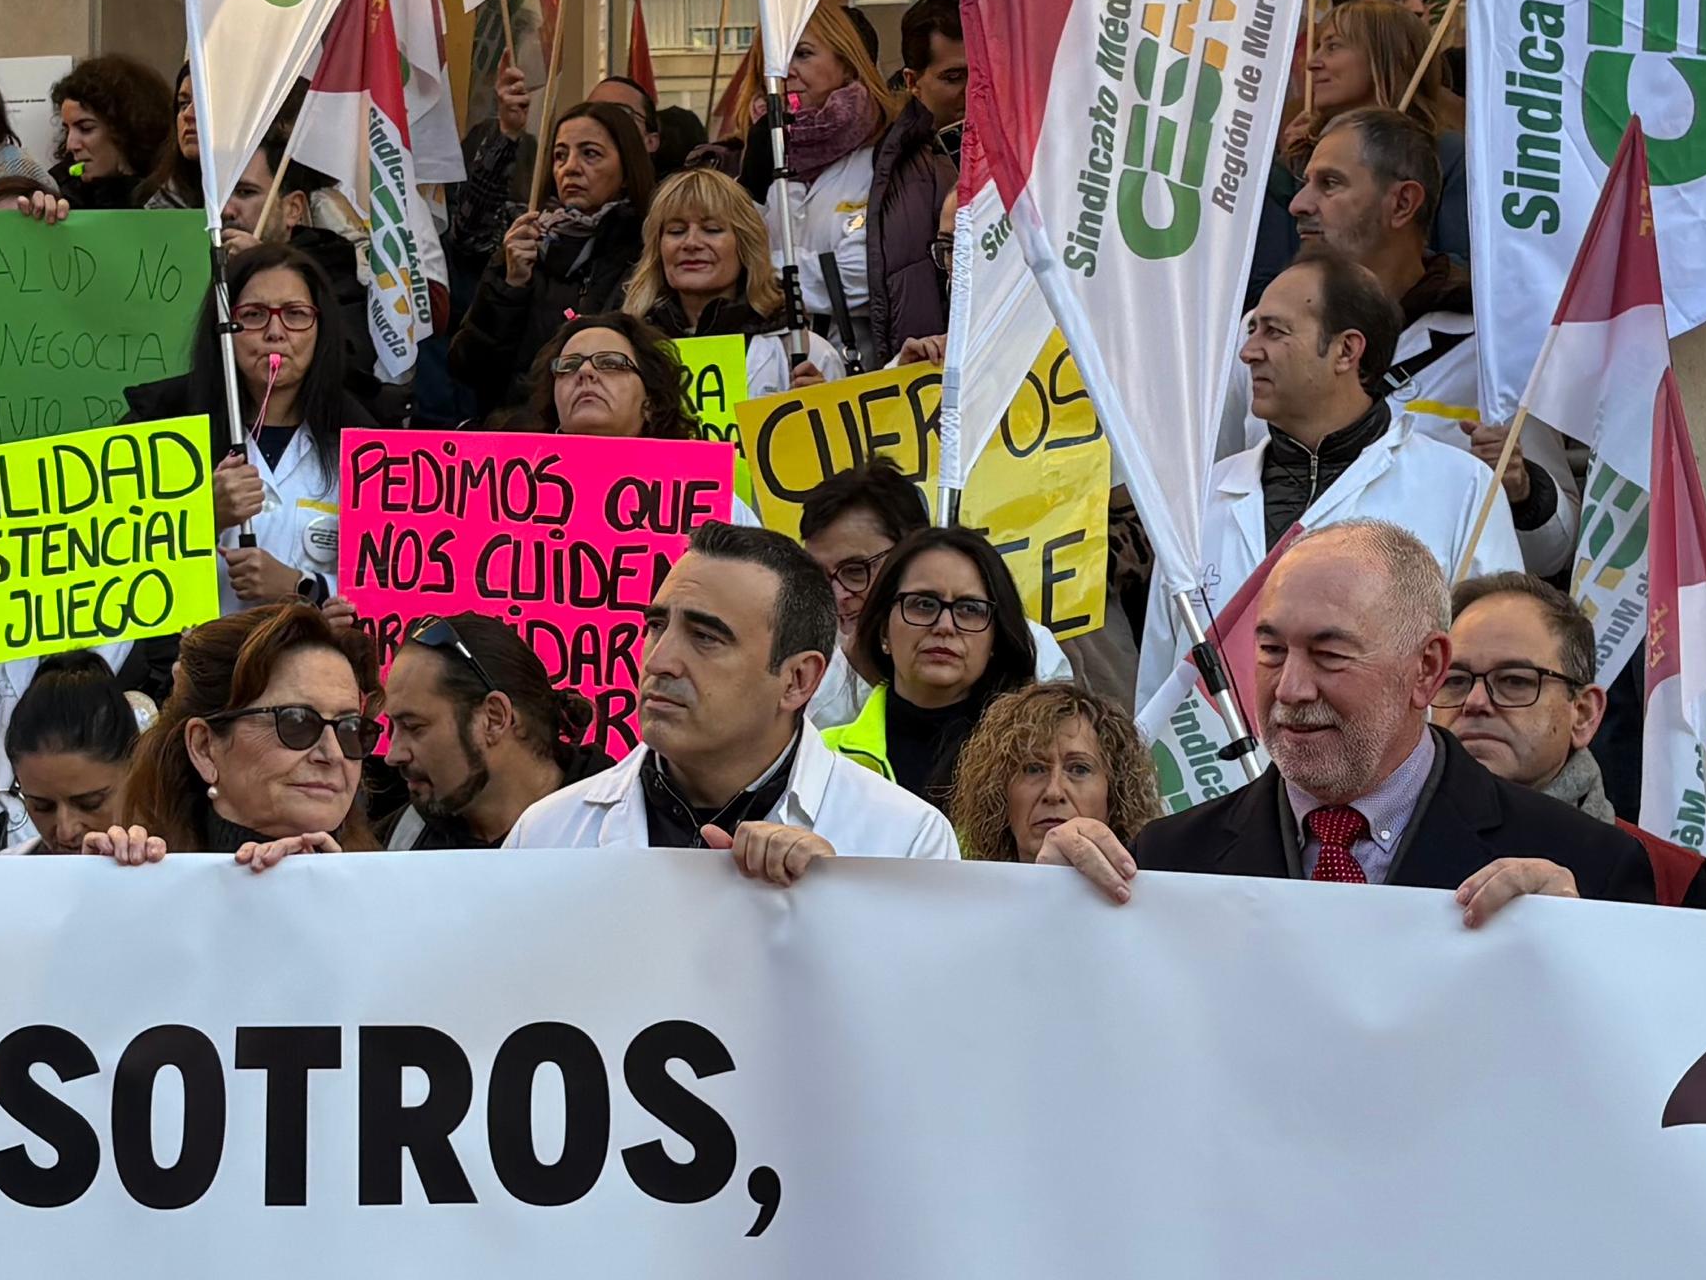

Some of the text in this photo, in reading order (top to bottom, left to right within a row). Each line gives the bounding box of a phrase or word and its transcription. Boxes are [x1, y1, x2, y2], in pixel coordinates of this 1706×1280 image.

[1211, 103, 1253, 216] Región
[1234, 57, 1265, 97] de
[1063, 84, 1123, 279] Sindicato
[132, 245, 183, 304] NO
[0, 325, 167, 375] NEGOCIA
[370, 297, 407, 359] Murcia
[605, 476, 720, 534] QUE
[355, 523, 455, 594] NOS
[4, 569, 174, 649] JUEGO
